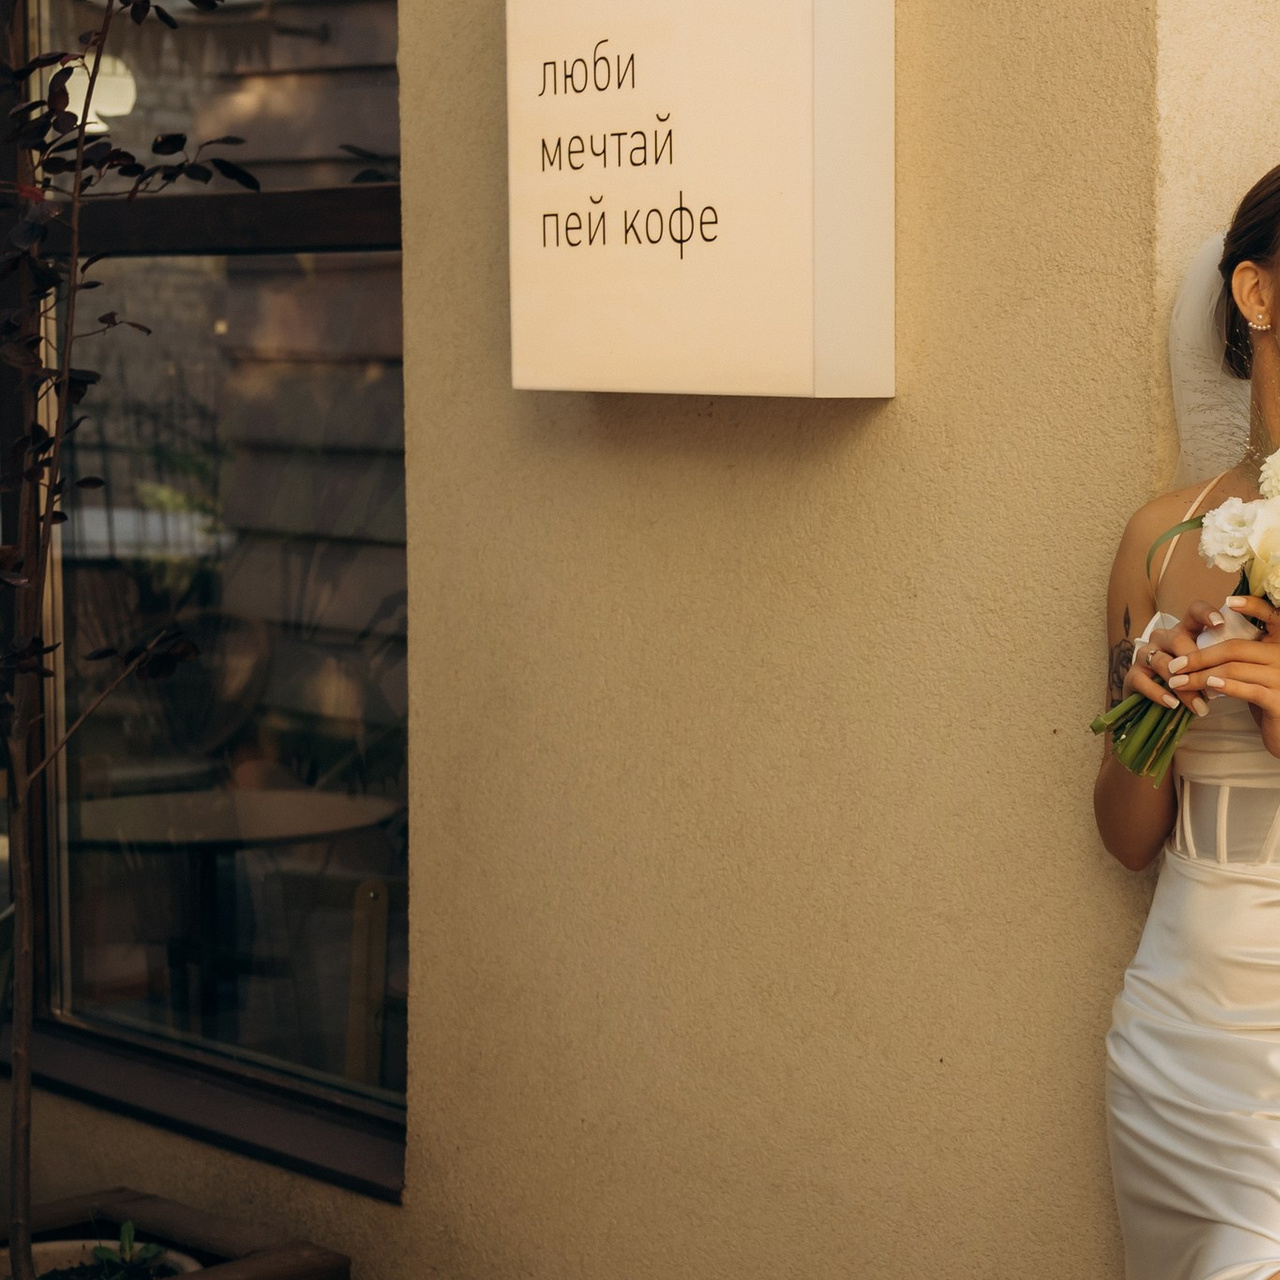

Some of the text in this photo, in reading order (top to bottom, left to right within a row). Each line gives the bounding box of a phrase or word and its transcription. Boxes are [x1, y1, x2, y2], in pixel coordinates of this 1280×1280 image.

[538, 39, 636, 97] люби
[540, 112, 674, 172] мечтай
[541, 190, 719, 260] пей кофе
